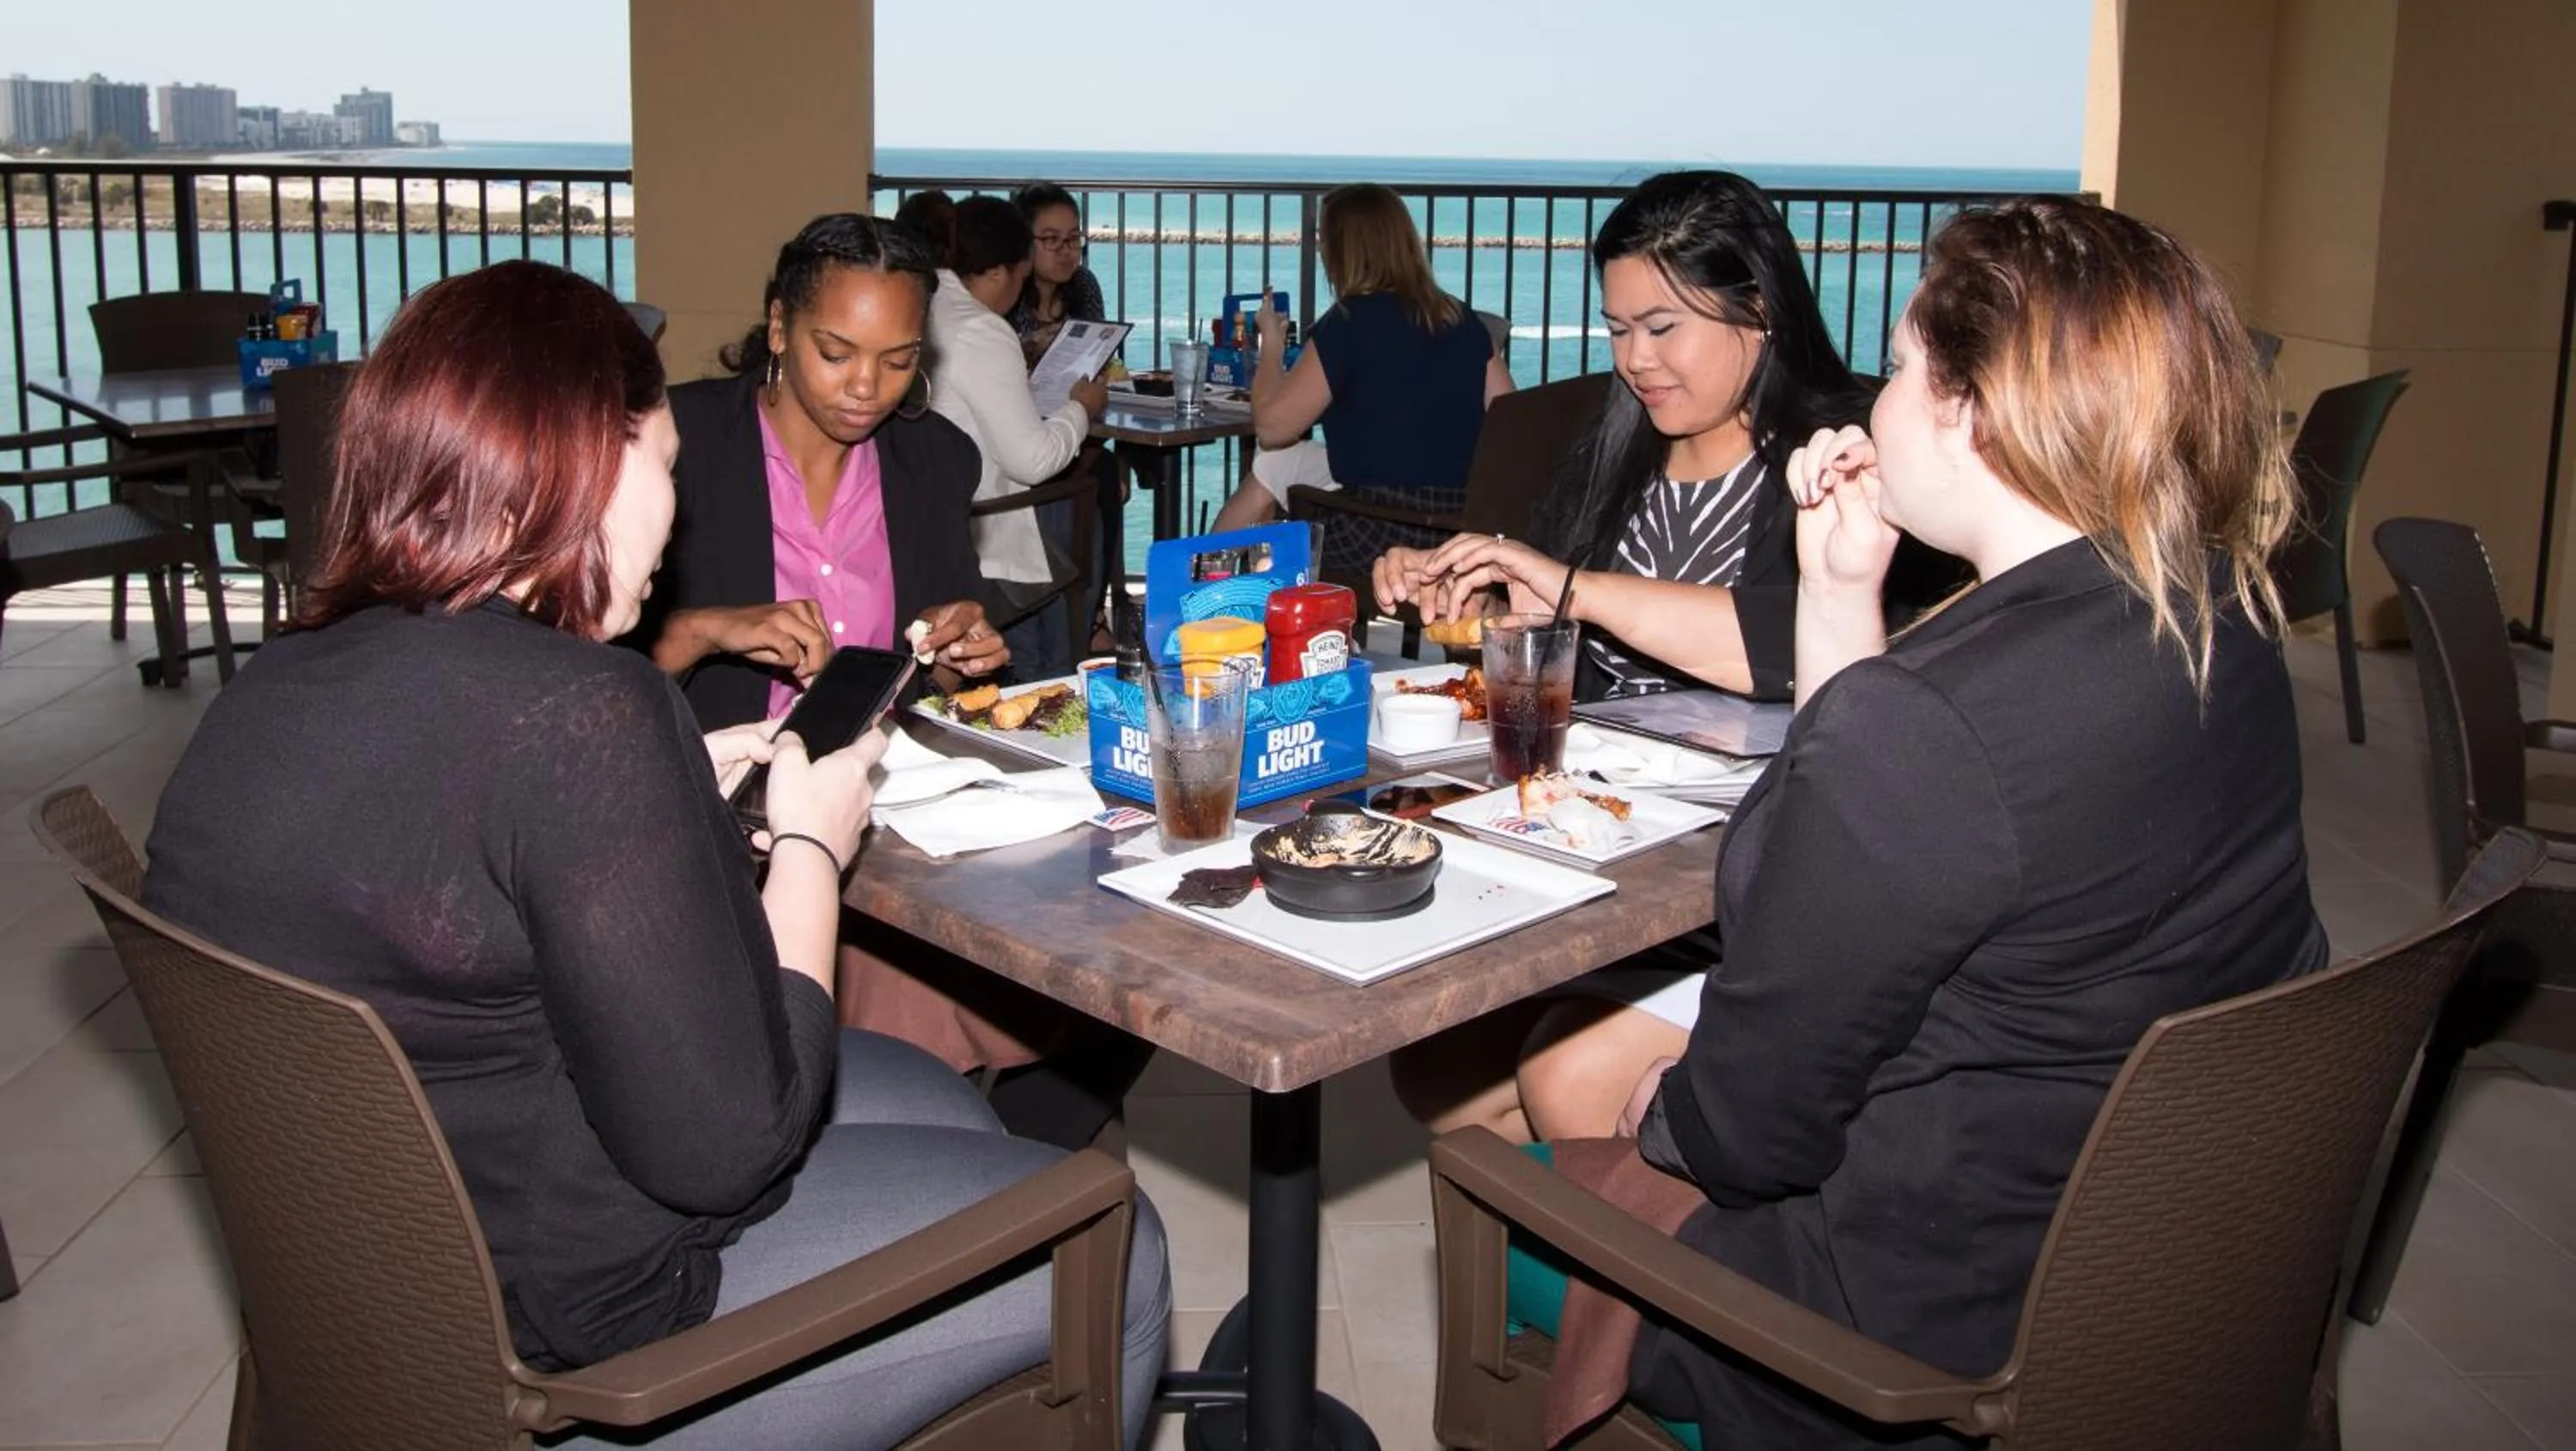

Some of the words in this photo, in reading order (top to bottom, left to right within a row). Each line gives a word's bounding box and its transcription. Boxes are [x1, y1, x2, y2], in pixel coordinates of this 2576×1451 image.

[1121, 726, 1150, 755] BU
[1267, 721, 1315, 753] BUD
[1113, 745, 1153, 779] LIG
[1258, 739, 1325, 779] LIGHT
